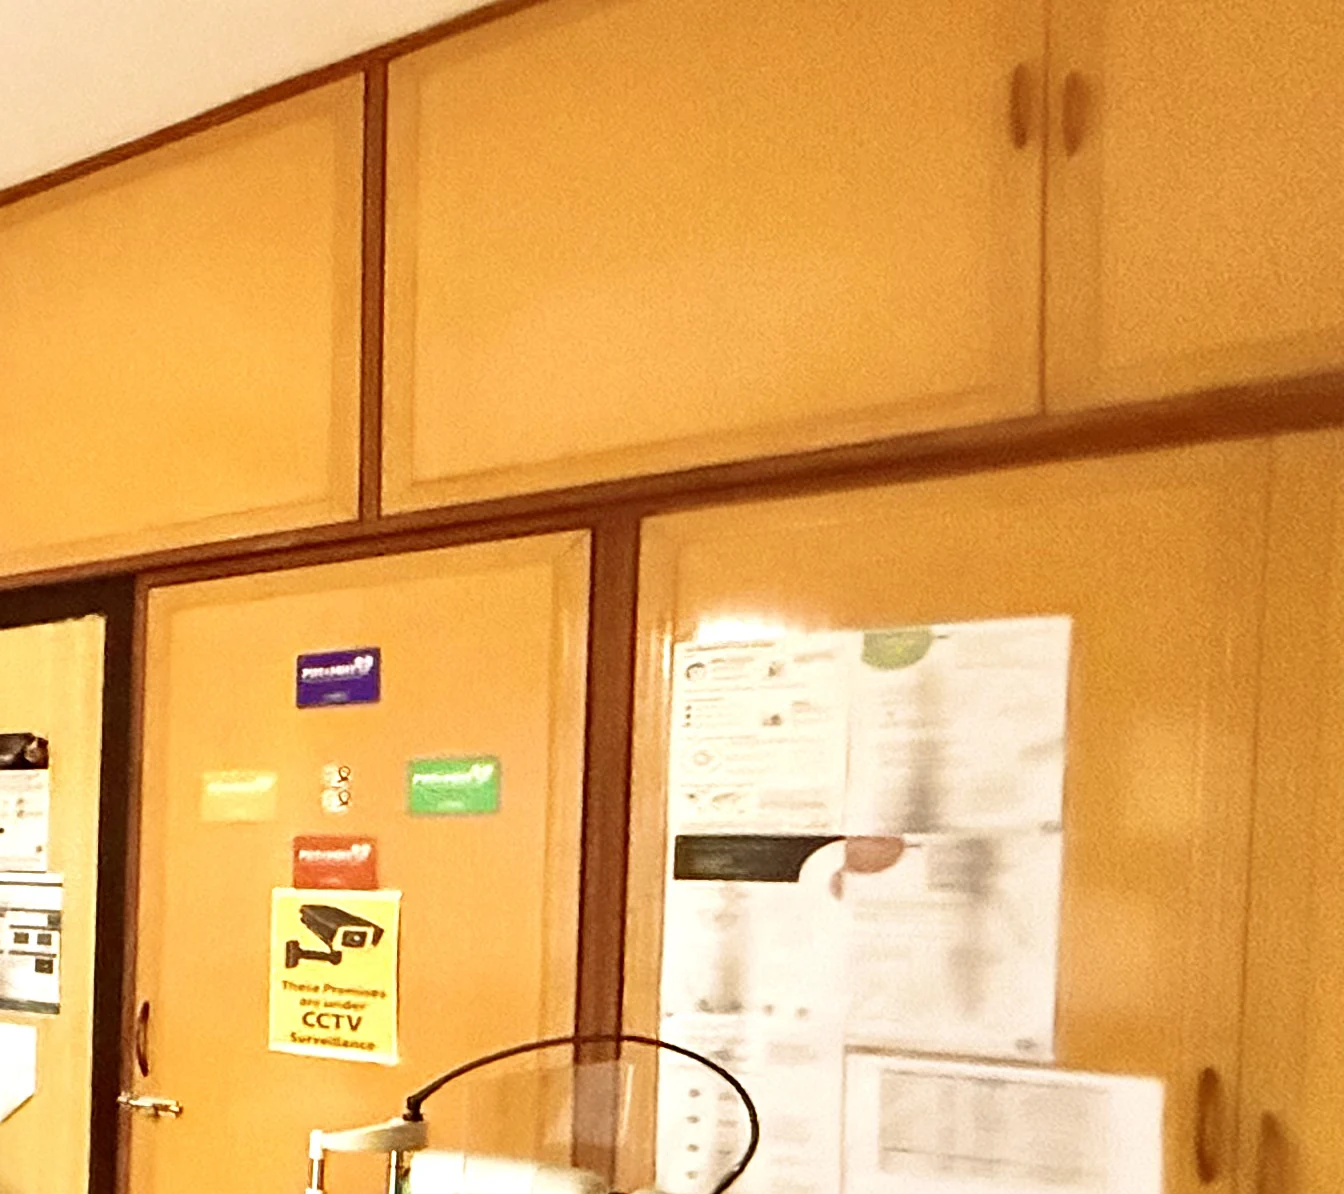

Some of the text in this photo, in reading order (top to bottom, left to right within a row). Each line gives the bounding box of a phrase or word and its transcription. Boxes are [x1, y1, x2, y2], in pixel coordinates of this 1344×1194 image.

[282, 979, 387, 999] These Premises
[299, 997, 367, 1011] are under
[301, 1010, 363, 1032] CCTV
[290, 1031, 376, 1051] Surveillance
